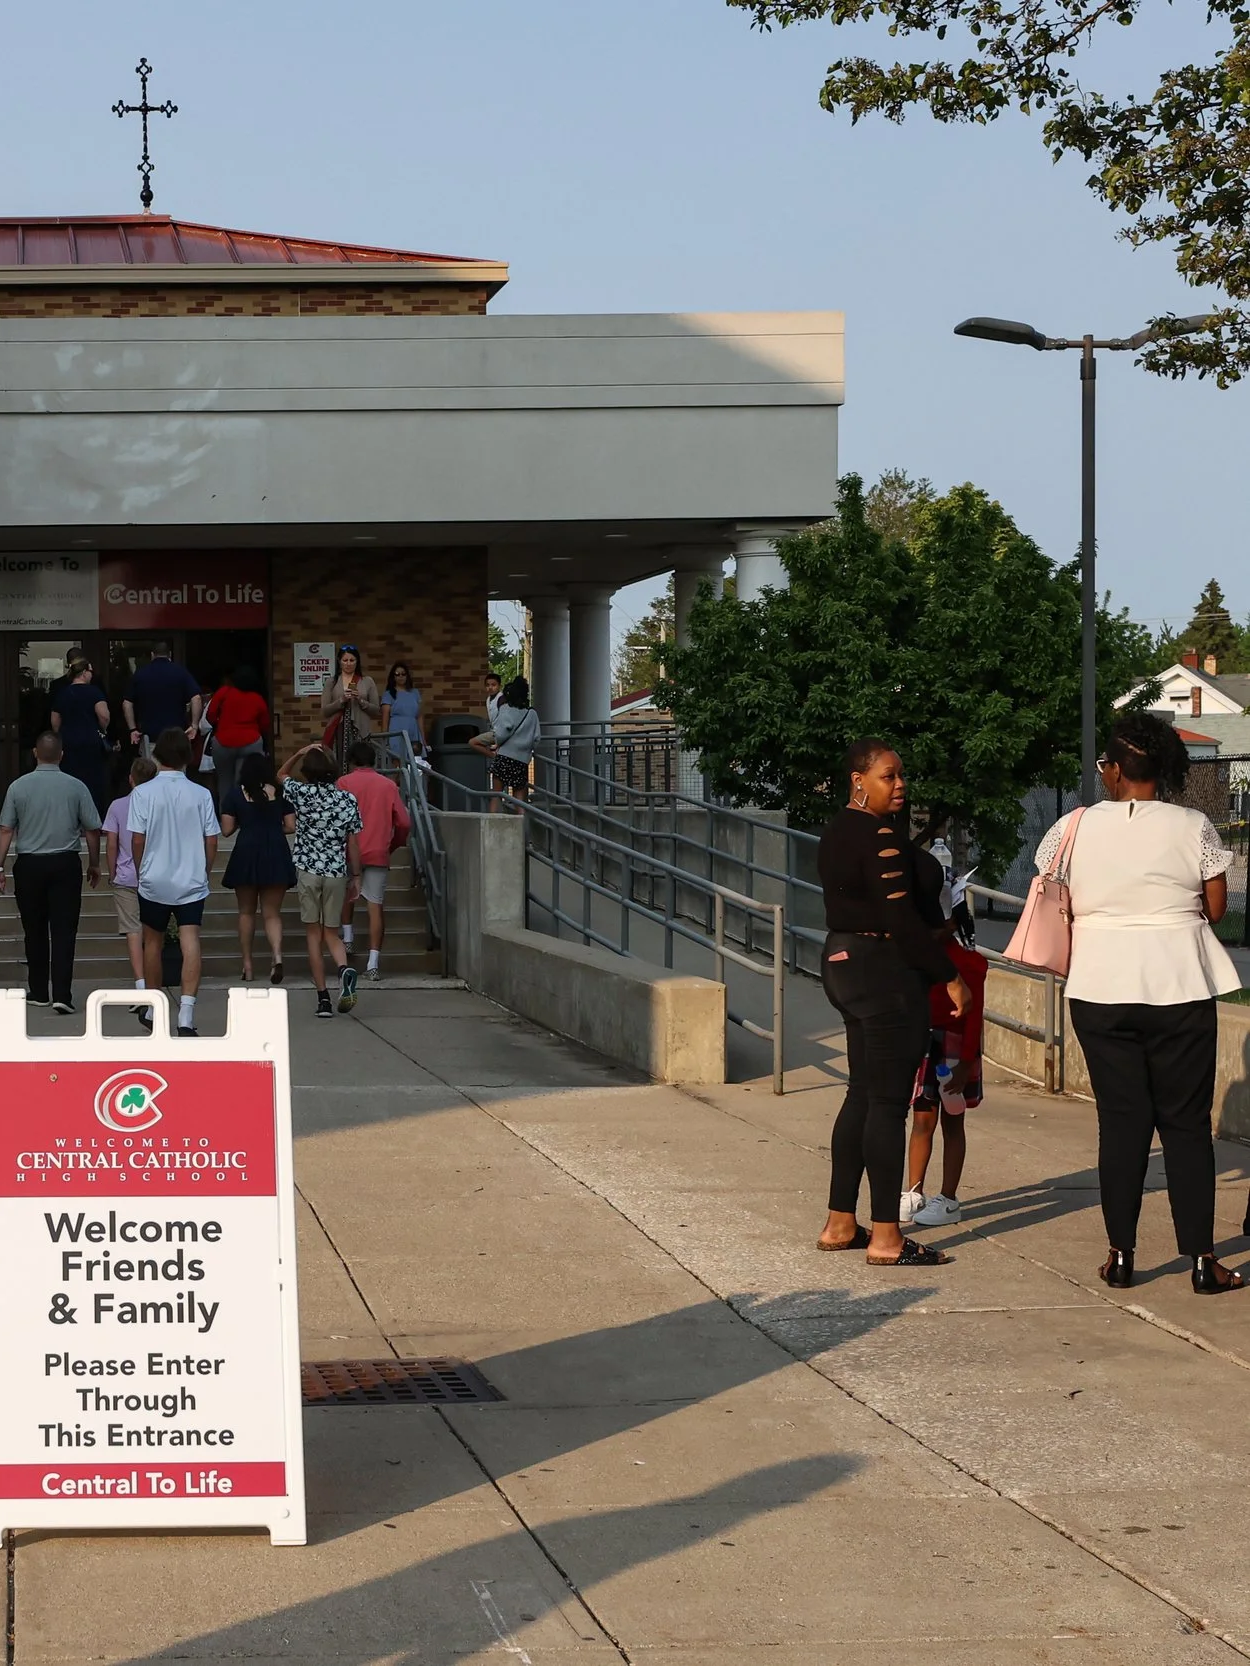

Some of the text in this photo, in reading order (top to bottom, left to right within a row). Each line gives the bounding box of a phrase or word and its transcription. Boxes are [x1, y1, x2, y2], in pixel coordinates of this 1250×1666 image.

[59, 556, 80, 571] To
[103, 583, 189, 605] Central
[192, 584, 220, 604] To
[223, 582, 265, 604] Life
[55, 1137, 209, 1148] WELCOME TO
[16, 1151, 247, 1170] CENTRAL CATHOLIC
[16, 1172, 248, 1182] HIGH SCHOOL
[44, 1211, 222, 1243] Welcome
[62, 1249, 205, 1282] Friends
[48, 1291, 220, 1333] & Family
[44, 1352, 226, 1377] Please Enter
[76, 1387, 196, 1418] Through
[39, 1423, 235, 1448] This Entrance
[41, 1471, 233, 1496] Central To Life
